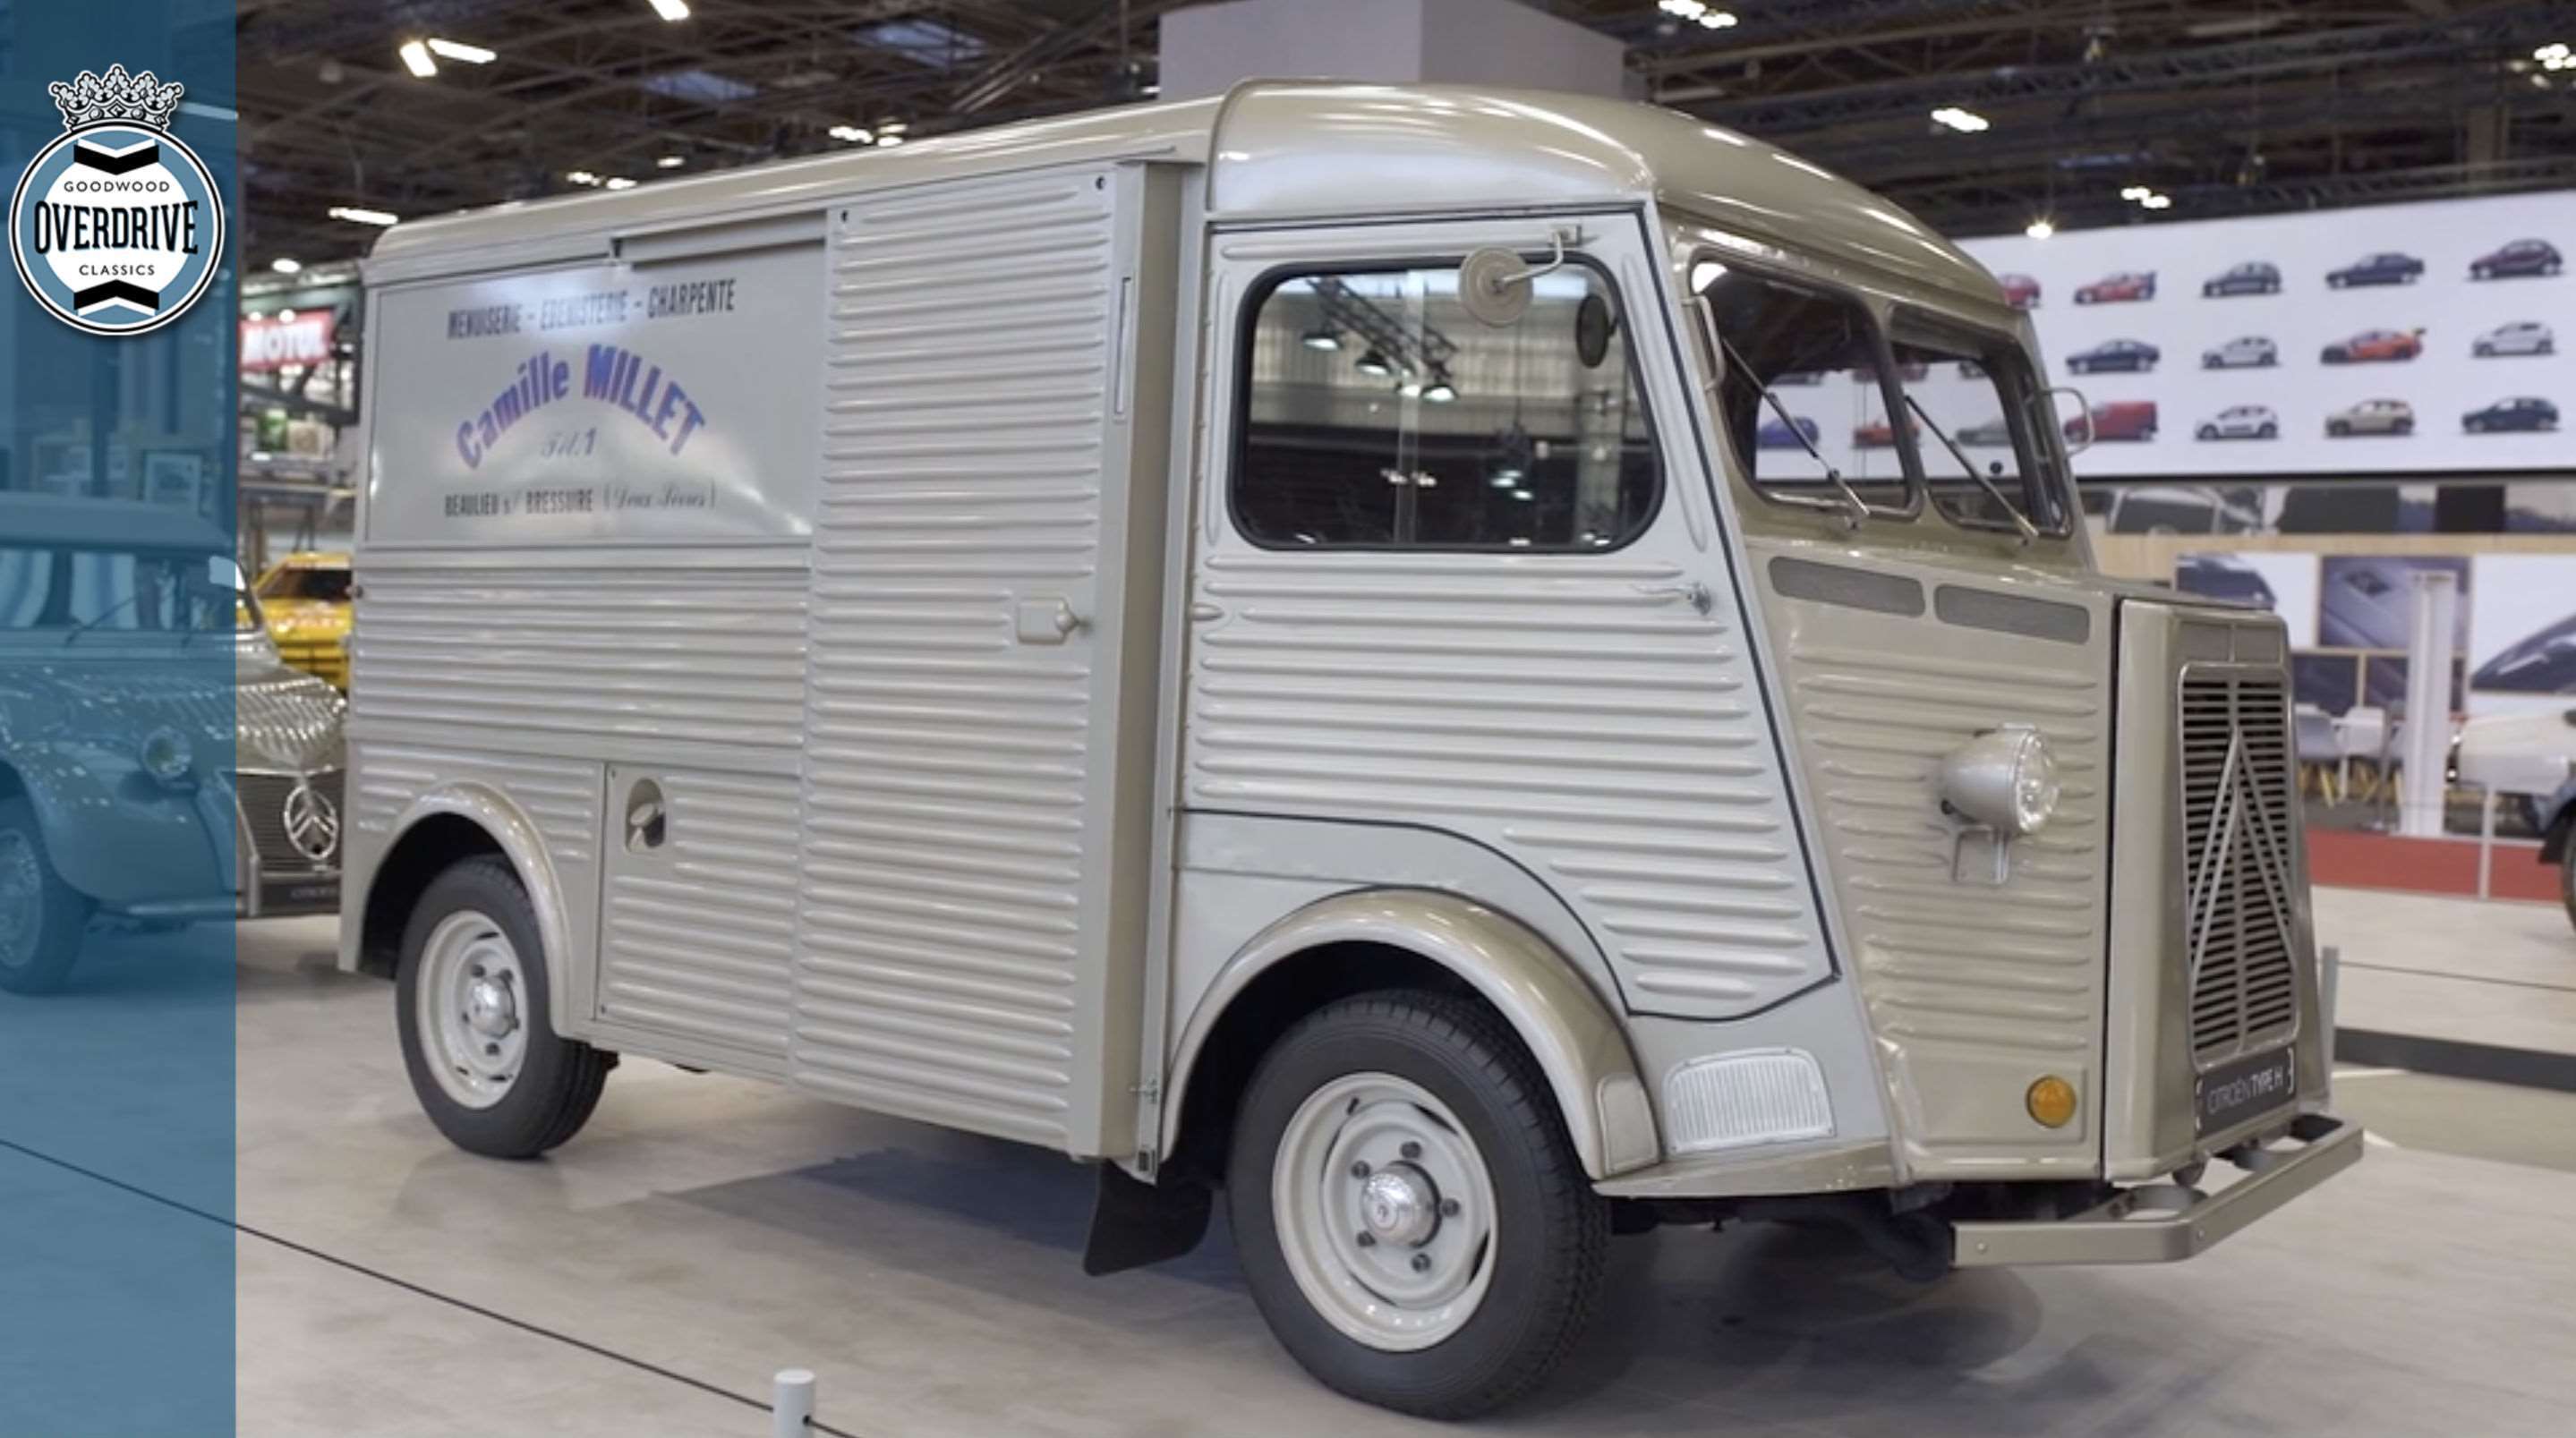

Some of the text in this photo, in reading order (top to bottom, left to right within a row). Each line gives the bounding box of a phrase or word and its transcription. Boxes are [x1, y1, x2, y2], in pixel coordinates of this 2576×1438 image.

[647, 278, 737, 319] CHARPENTE
[456, 343, 706, 470] Camille MILLET
[444, 491, 500, 518] BEAULIEU
